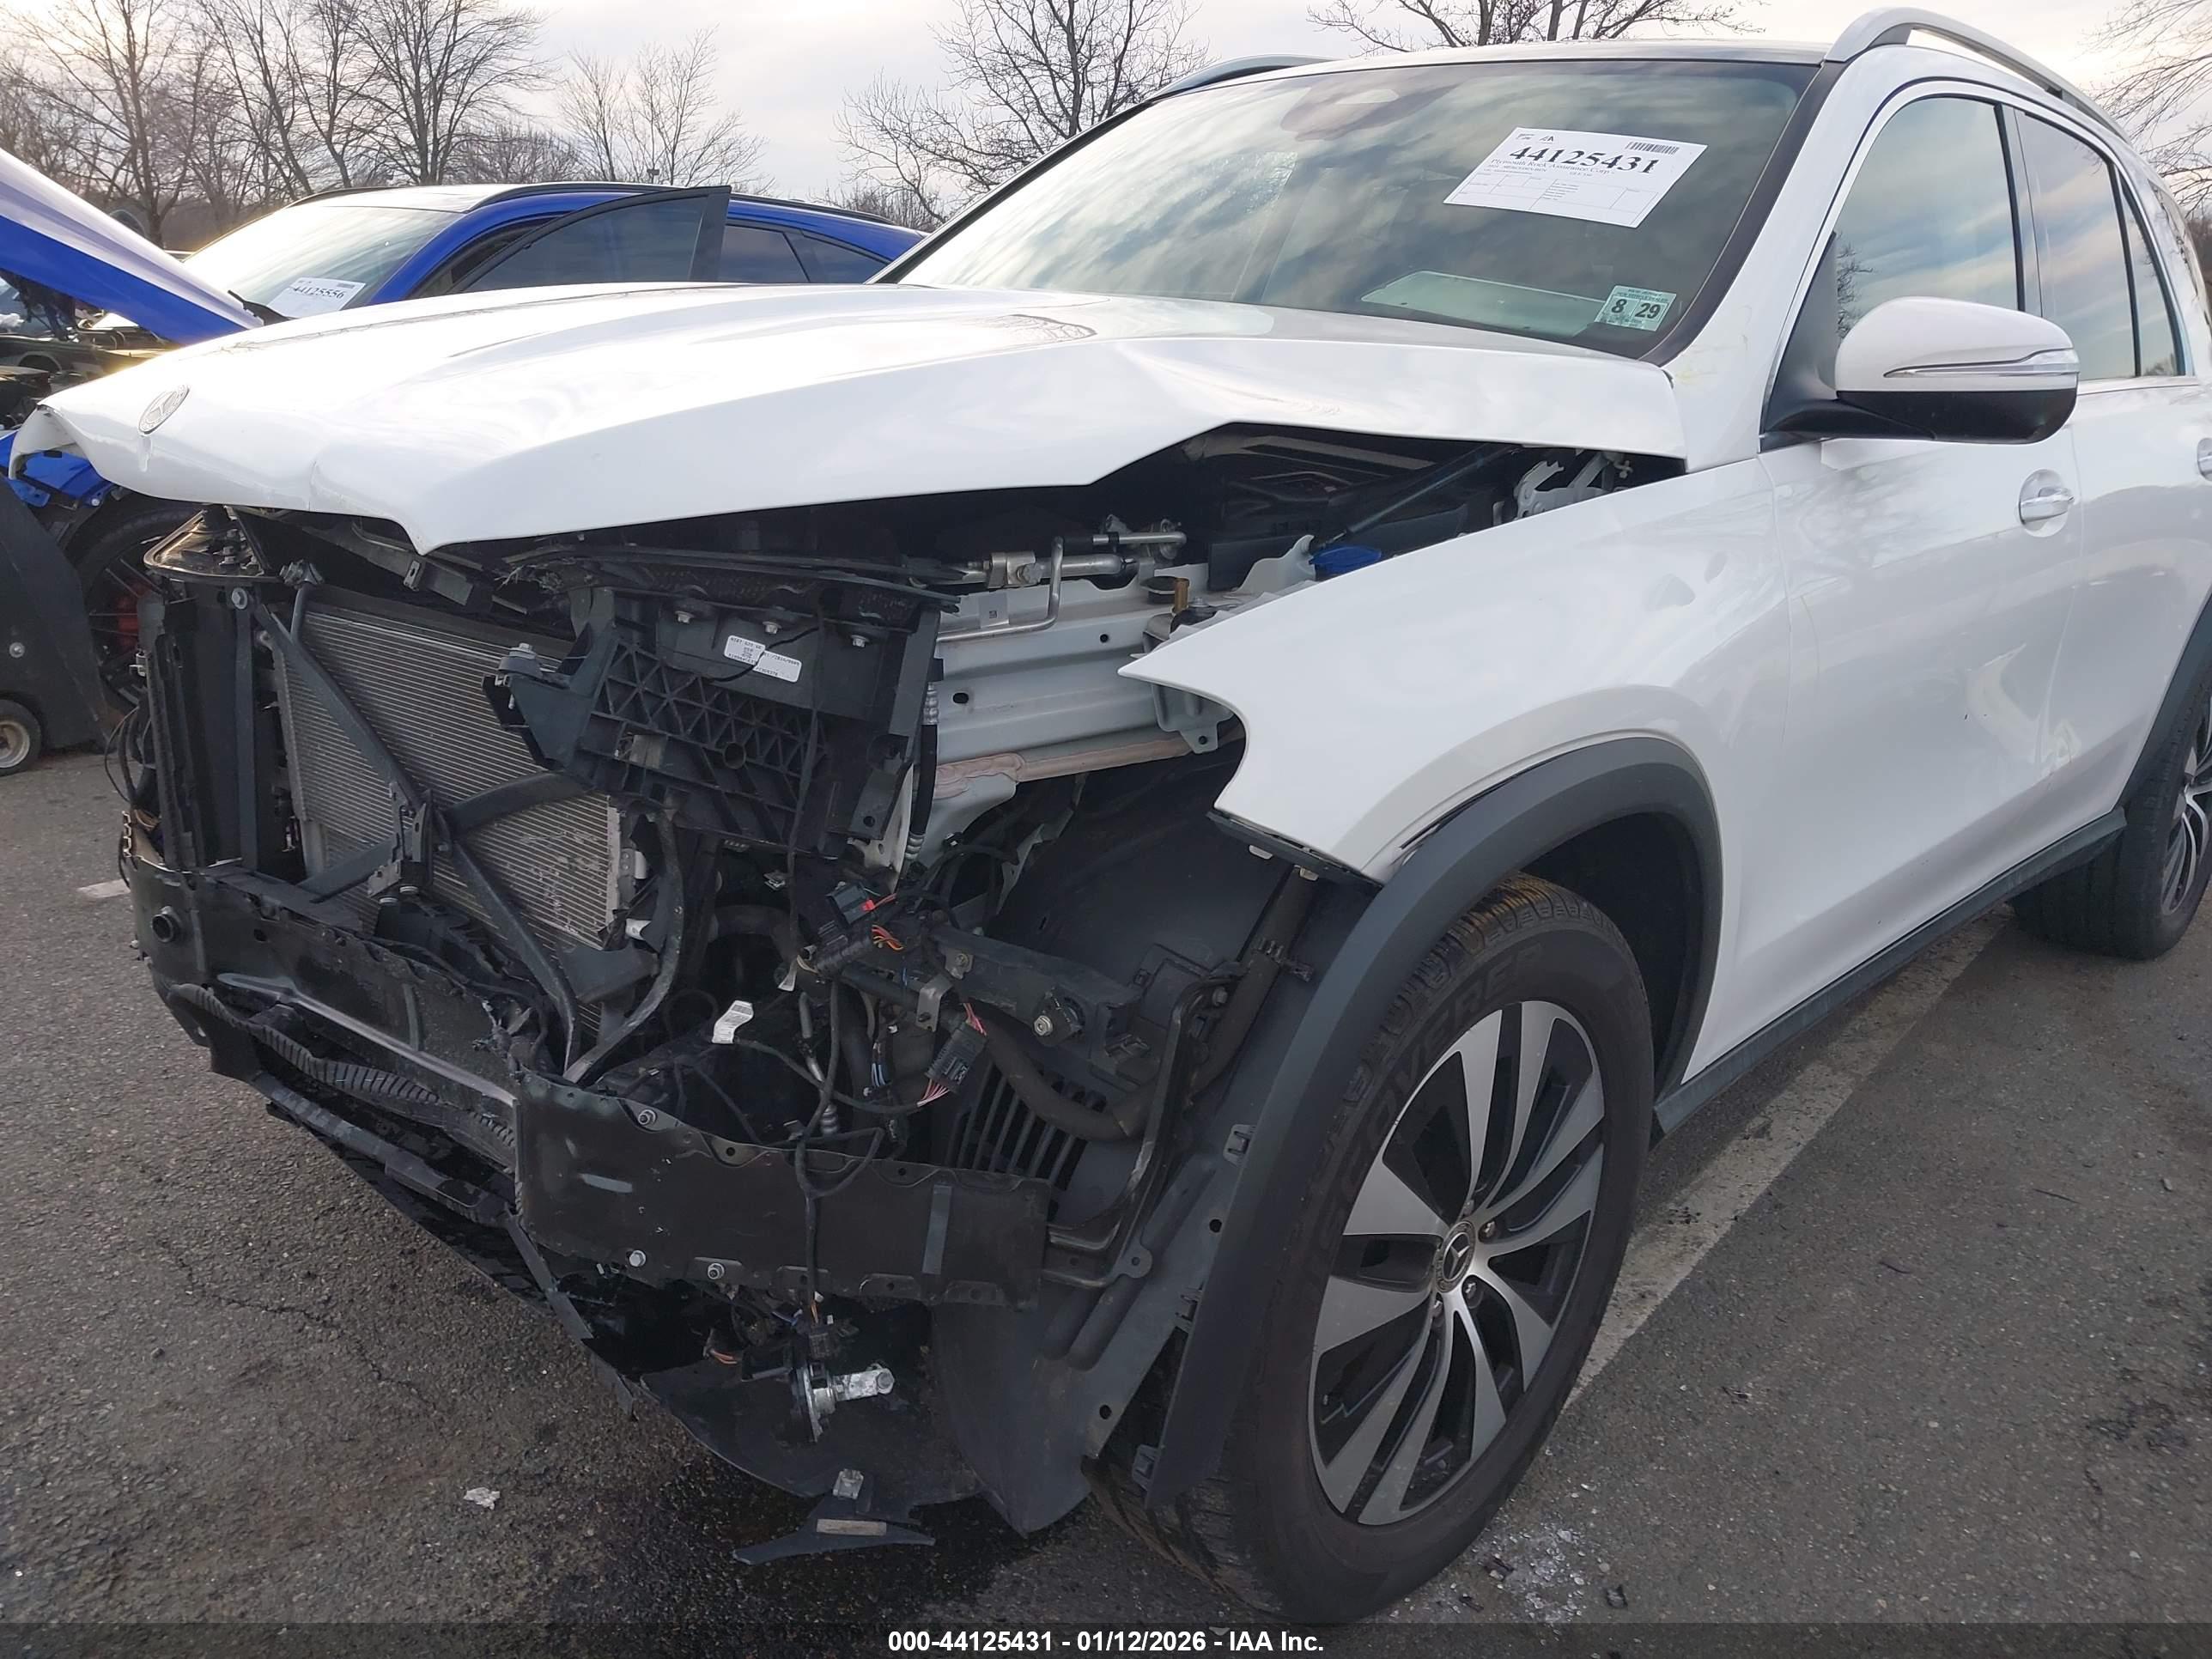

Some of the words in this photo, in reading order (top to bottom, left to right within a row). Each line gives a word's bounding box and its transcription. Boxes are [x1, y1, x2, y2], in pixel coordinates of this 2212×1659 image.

[1510, 146, 1659, 173] 44125431
[1611, 298, 1627, 313] 8
[1635, 302, 1661, 319] 29
